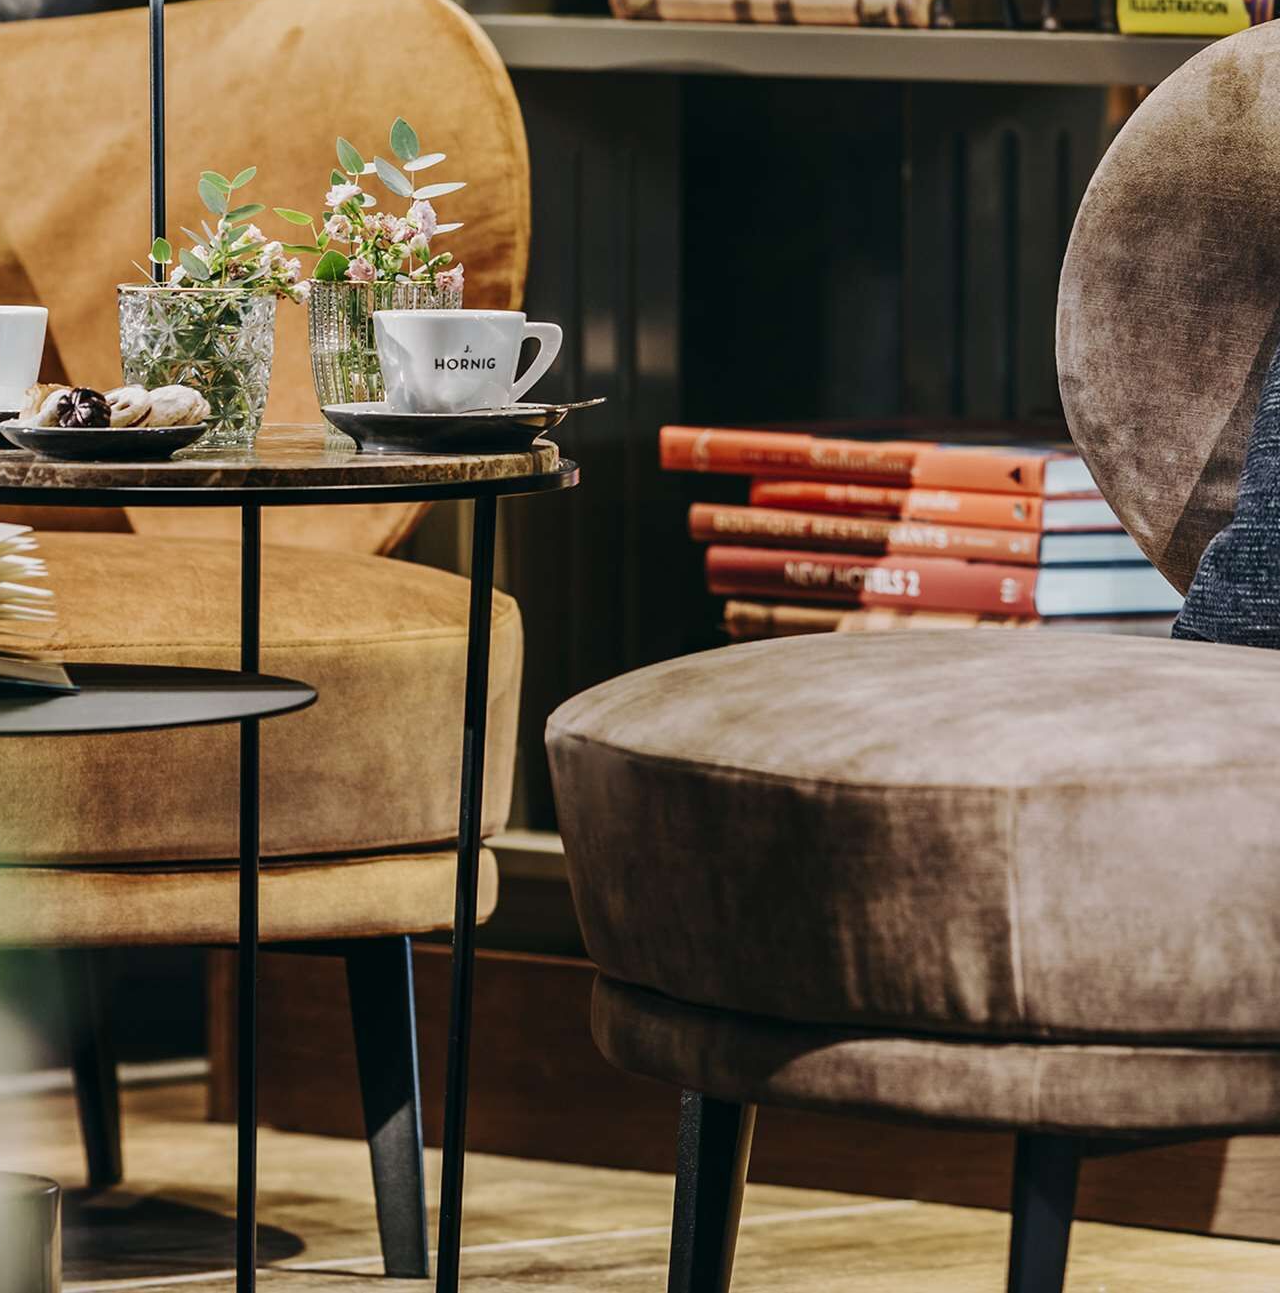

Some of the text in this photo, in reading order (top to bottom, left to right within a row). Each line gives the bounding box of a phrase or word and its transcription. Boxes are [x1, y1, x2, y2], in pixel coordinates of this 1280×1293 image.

[463, 344, 473, 354] J.
[434, 357, 496, 370] HORNIG
[785, 561, 921, 597] NEW HOTELS 2
